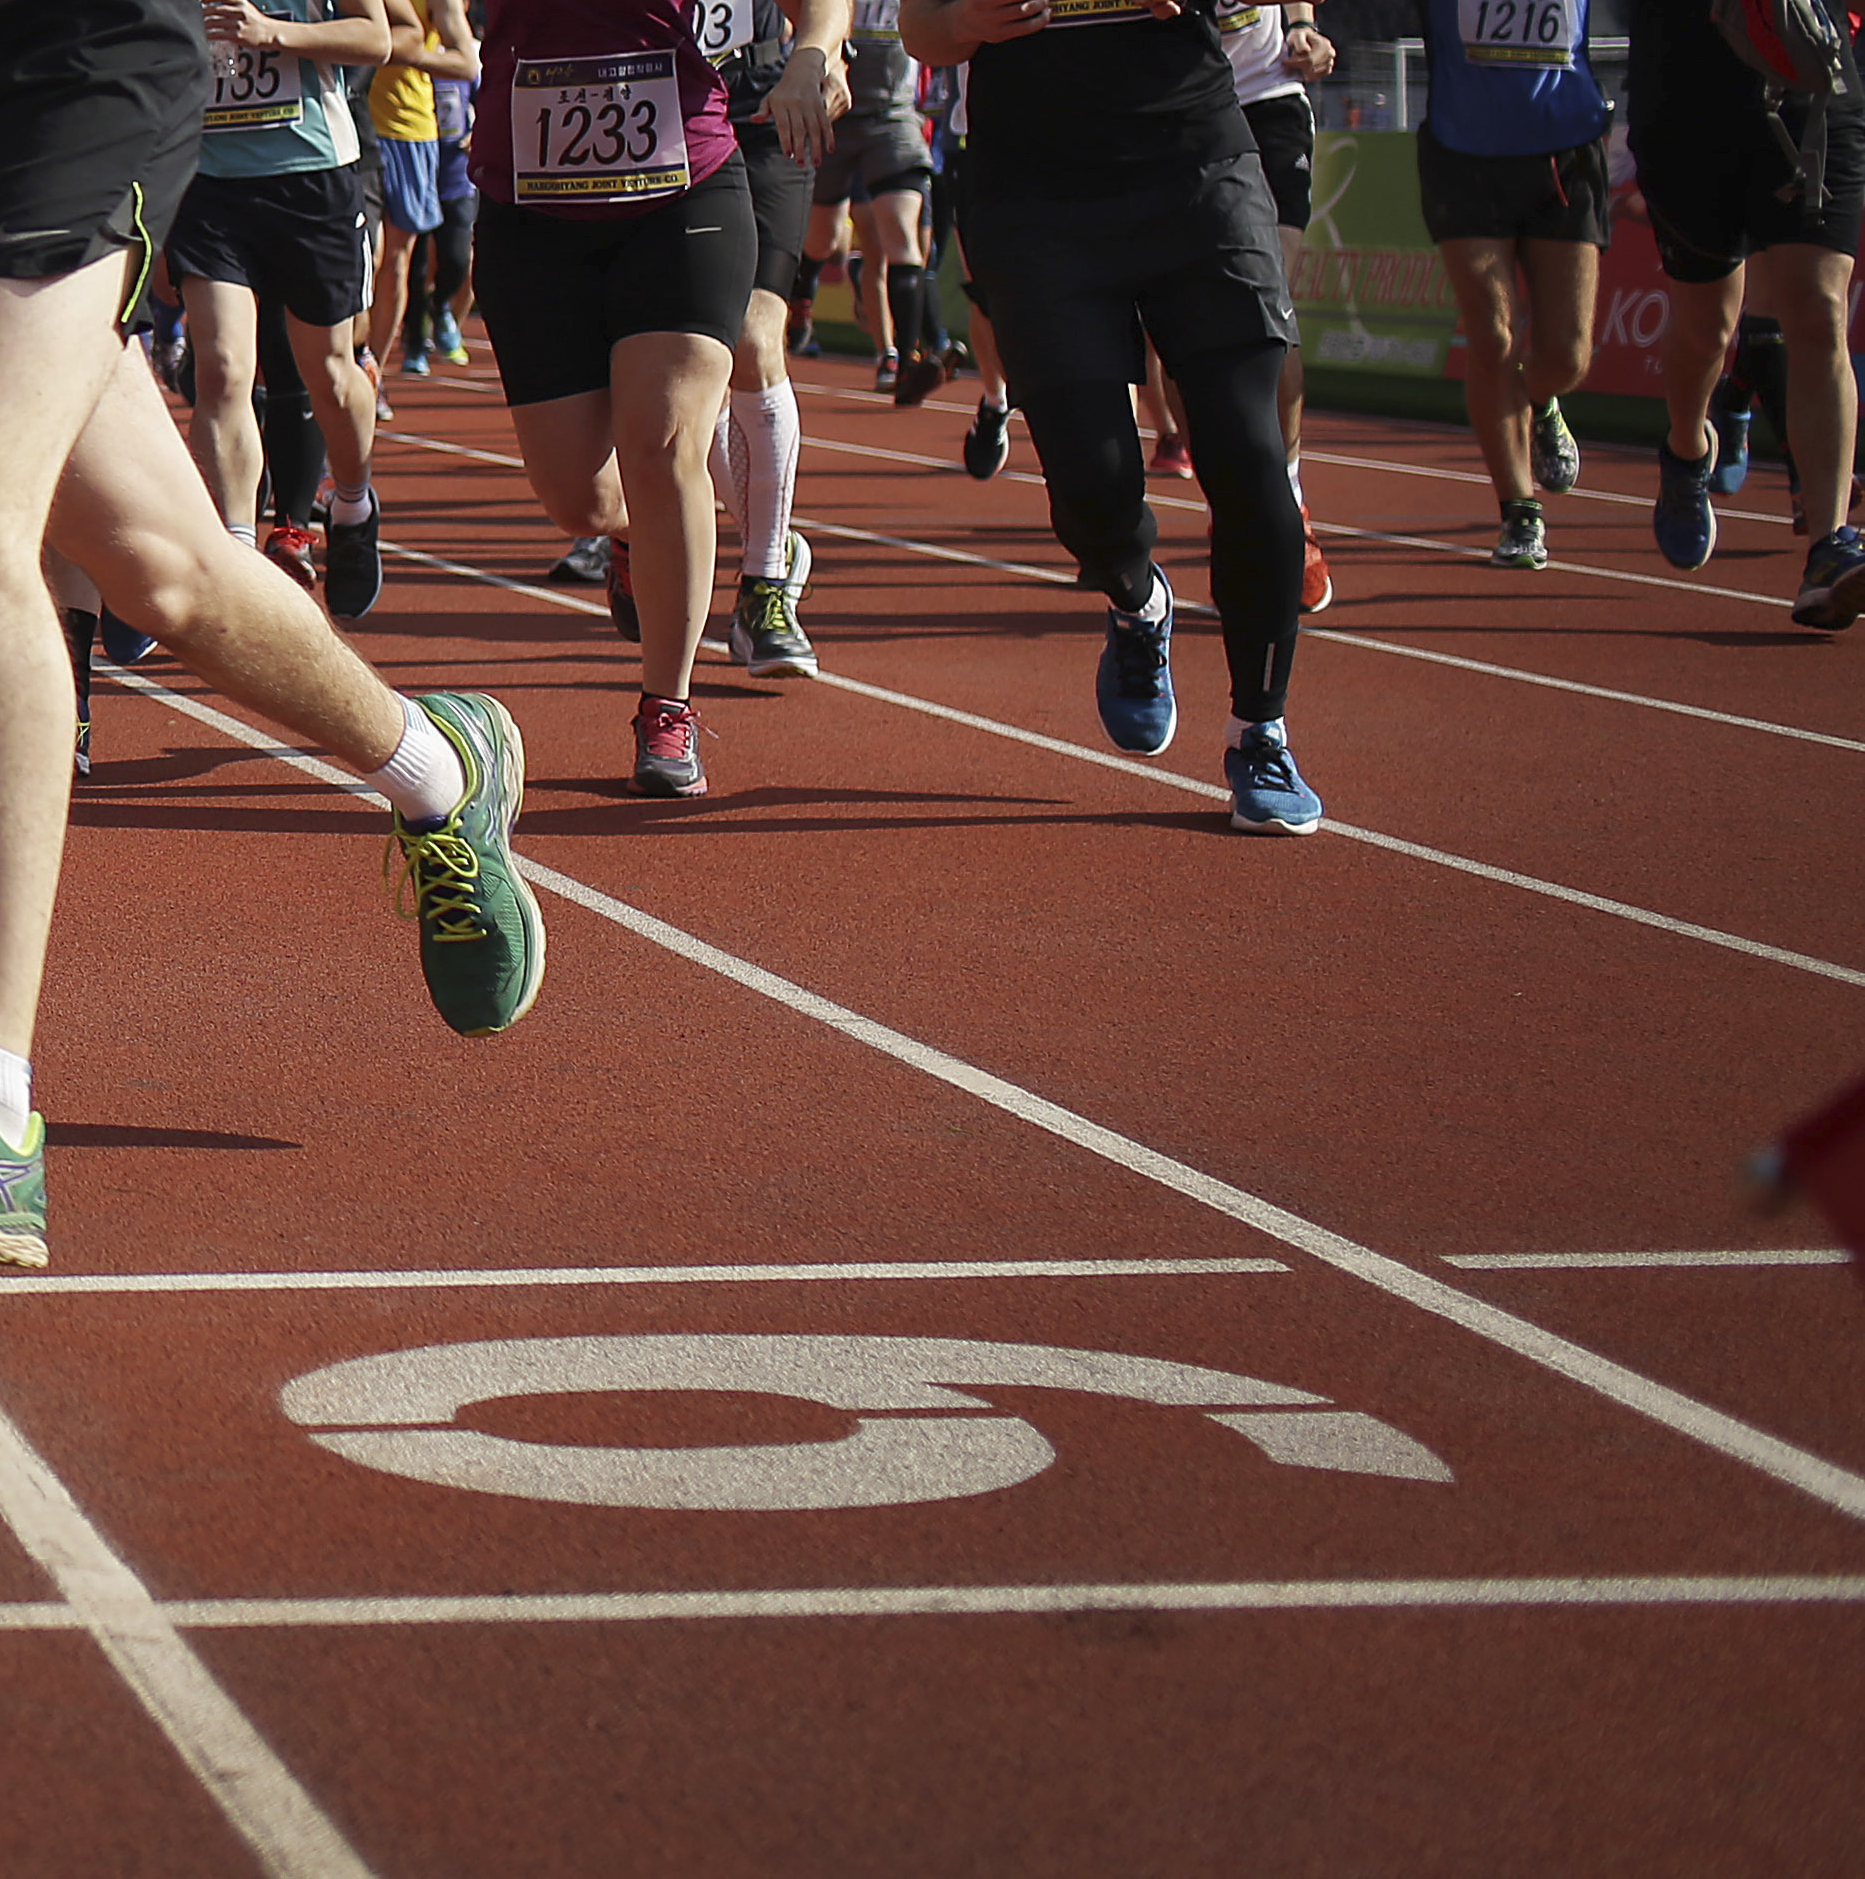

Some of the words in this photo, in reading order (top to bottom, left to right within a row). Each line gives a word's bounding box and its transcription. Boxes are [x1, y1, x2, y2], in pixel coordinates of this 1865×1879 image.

[1476, 0, 1561, 43] 1216
[536, 99, 658, 168] 1233
[592, 179, 618, 190] JOINT
[621, 176, 662, 188] VENTURE
[277, 1332, 1448, 1512] 6
